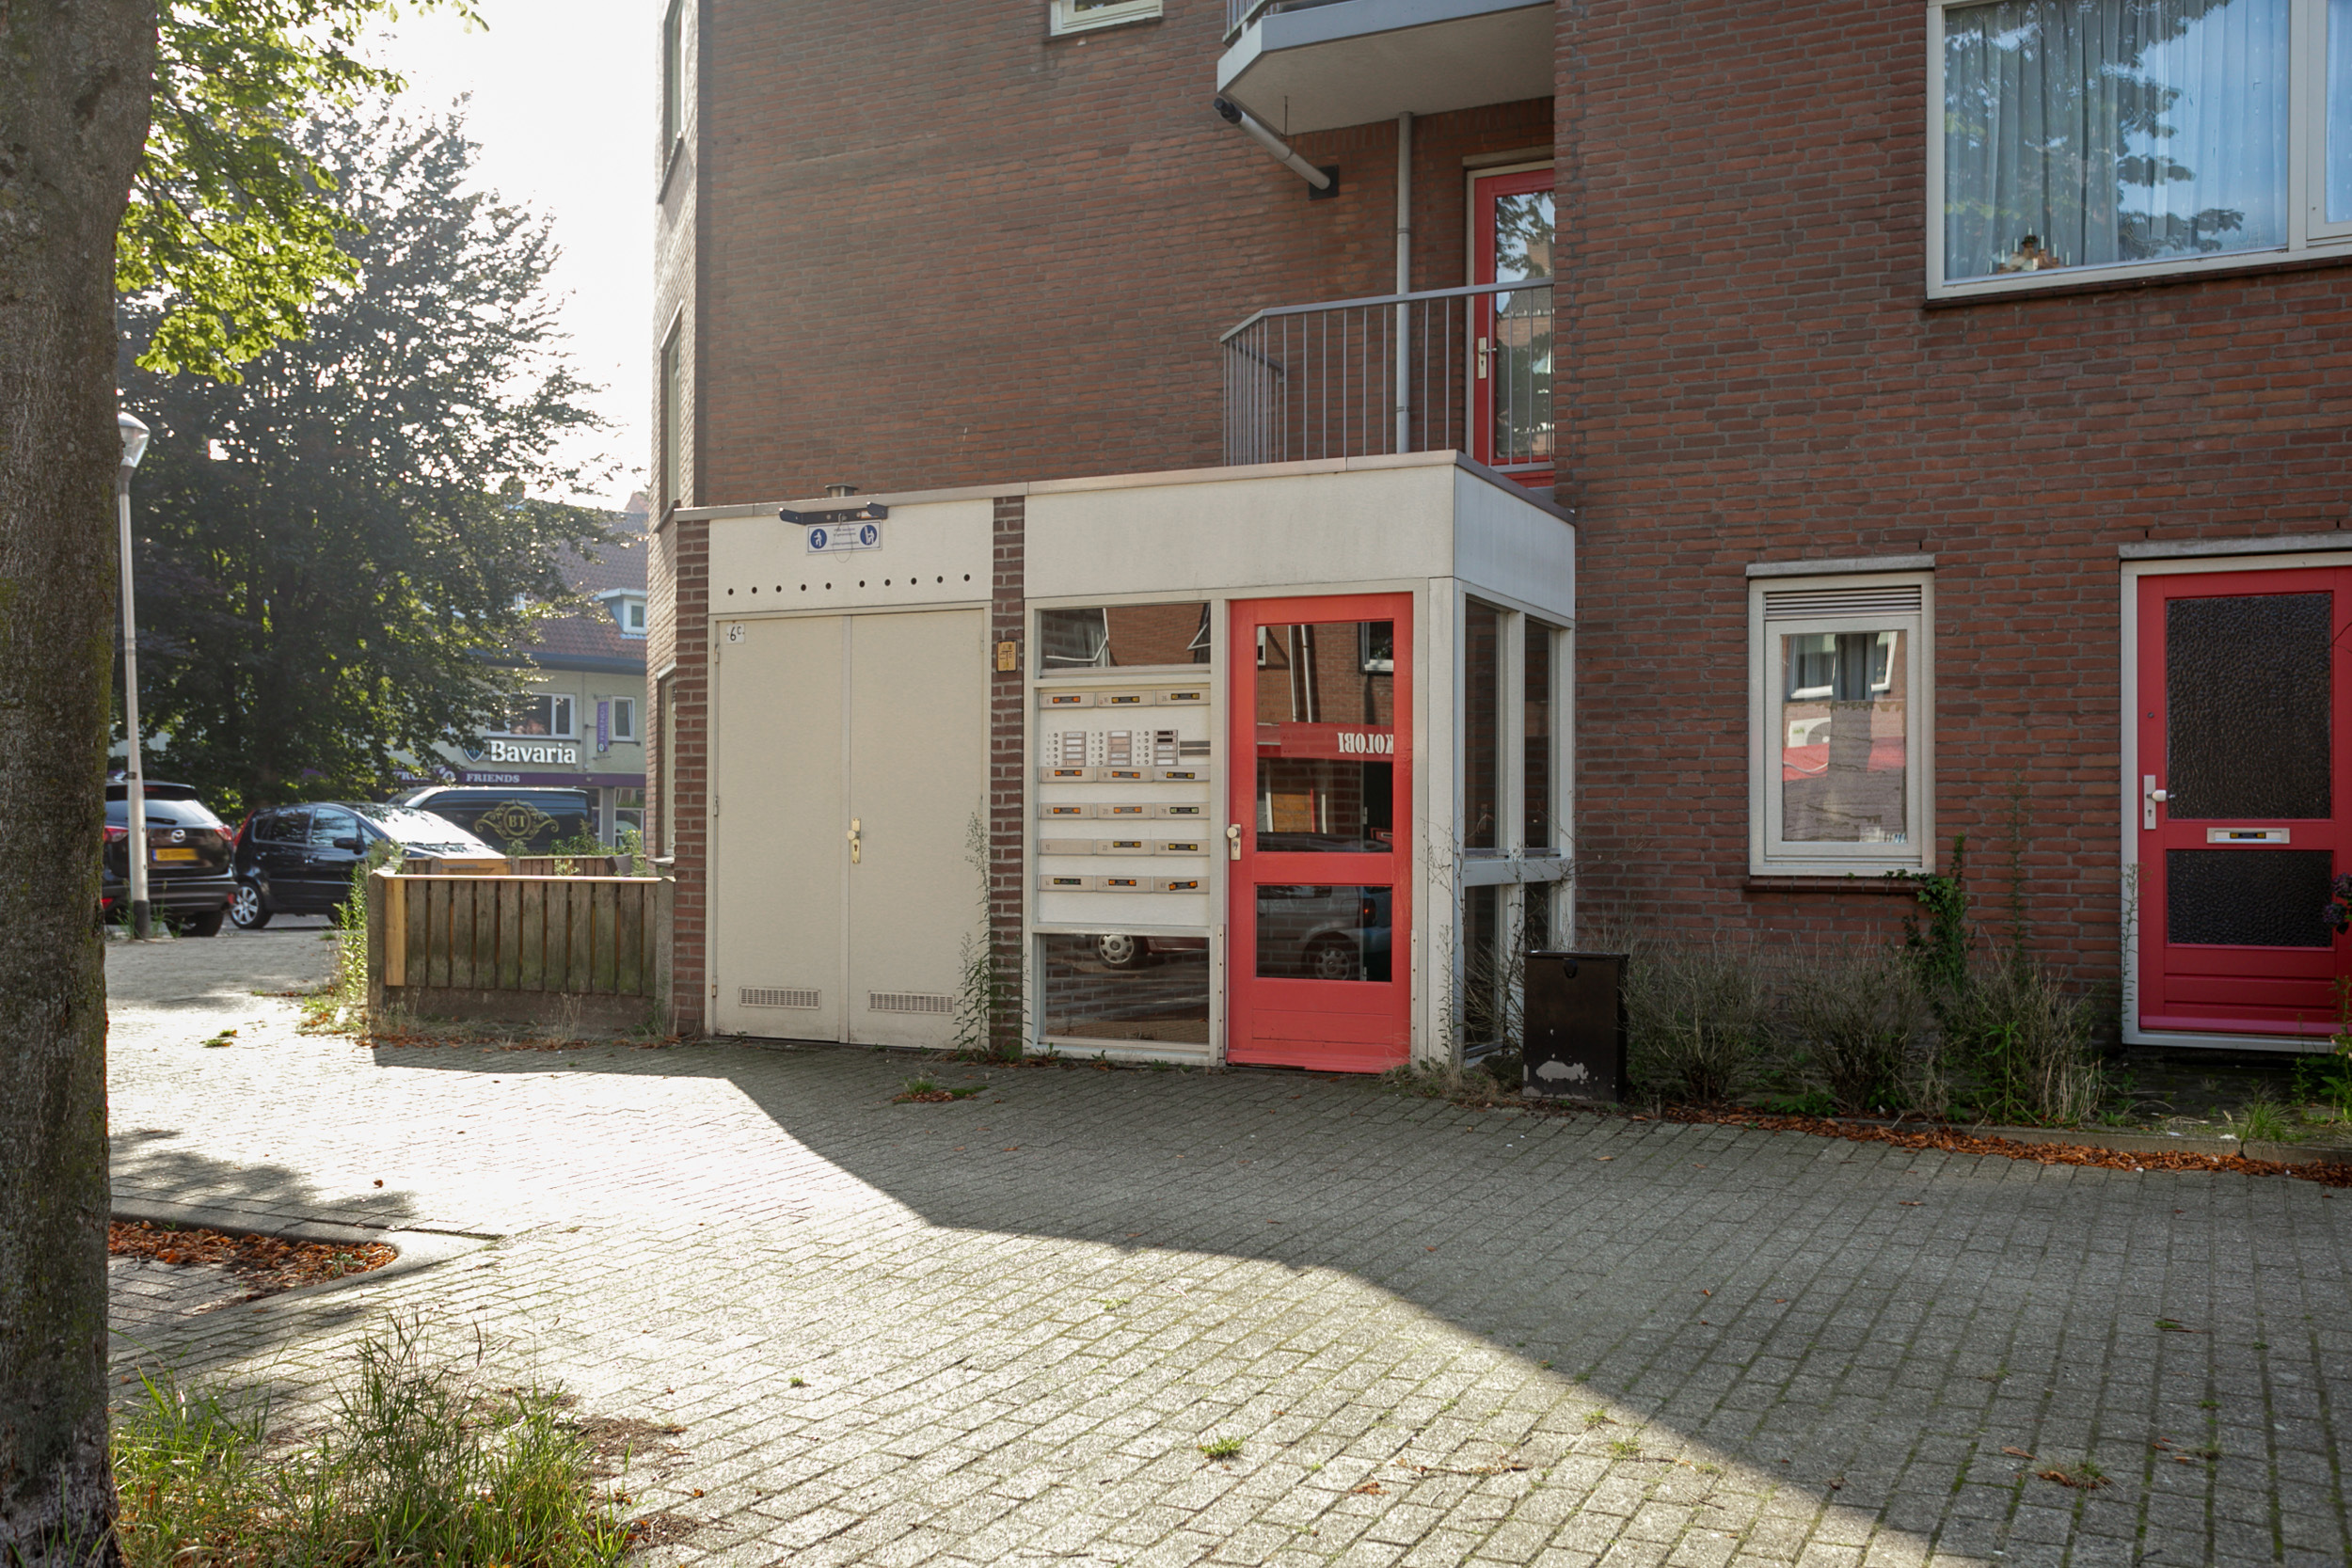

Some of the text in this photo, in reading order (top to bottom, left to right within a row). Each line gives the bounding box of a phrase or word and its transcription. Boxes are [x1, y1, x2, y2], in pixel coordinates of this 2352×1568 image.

[490, 740, 577, 765] Bavaria
[466, 773, 520, 784] FRIENDS
[508, 815, 526, 828] BT
